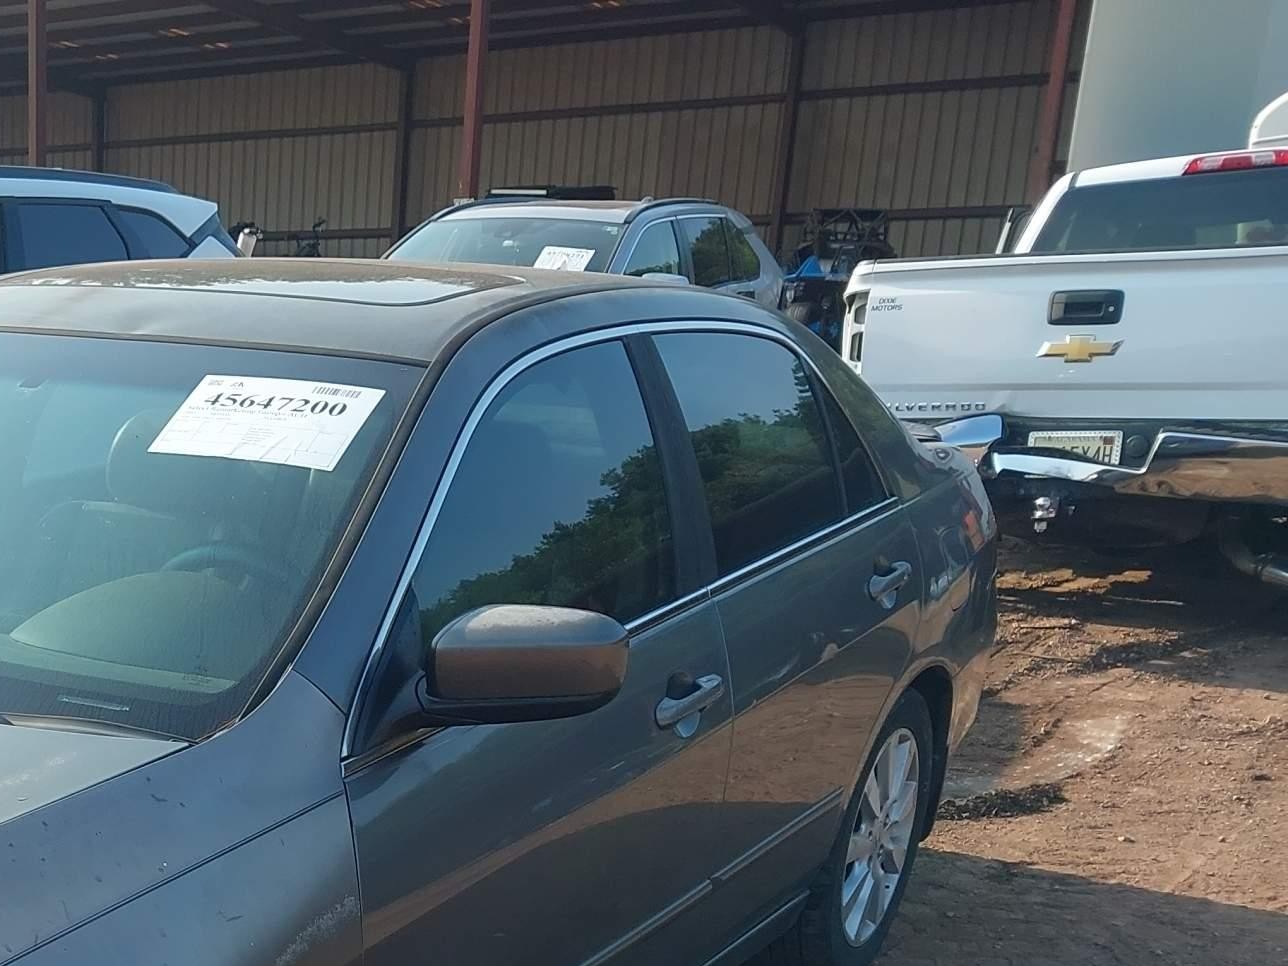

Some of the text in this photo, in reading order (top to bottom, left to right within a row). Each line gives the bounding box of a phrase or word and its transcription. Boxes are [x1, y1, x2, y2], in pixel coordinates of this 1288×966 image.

[871, 304, 903, 312] MOTORS
[204, 392, 348, 417] 45647200
[888, 402, 988, 412] LVERADO
